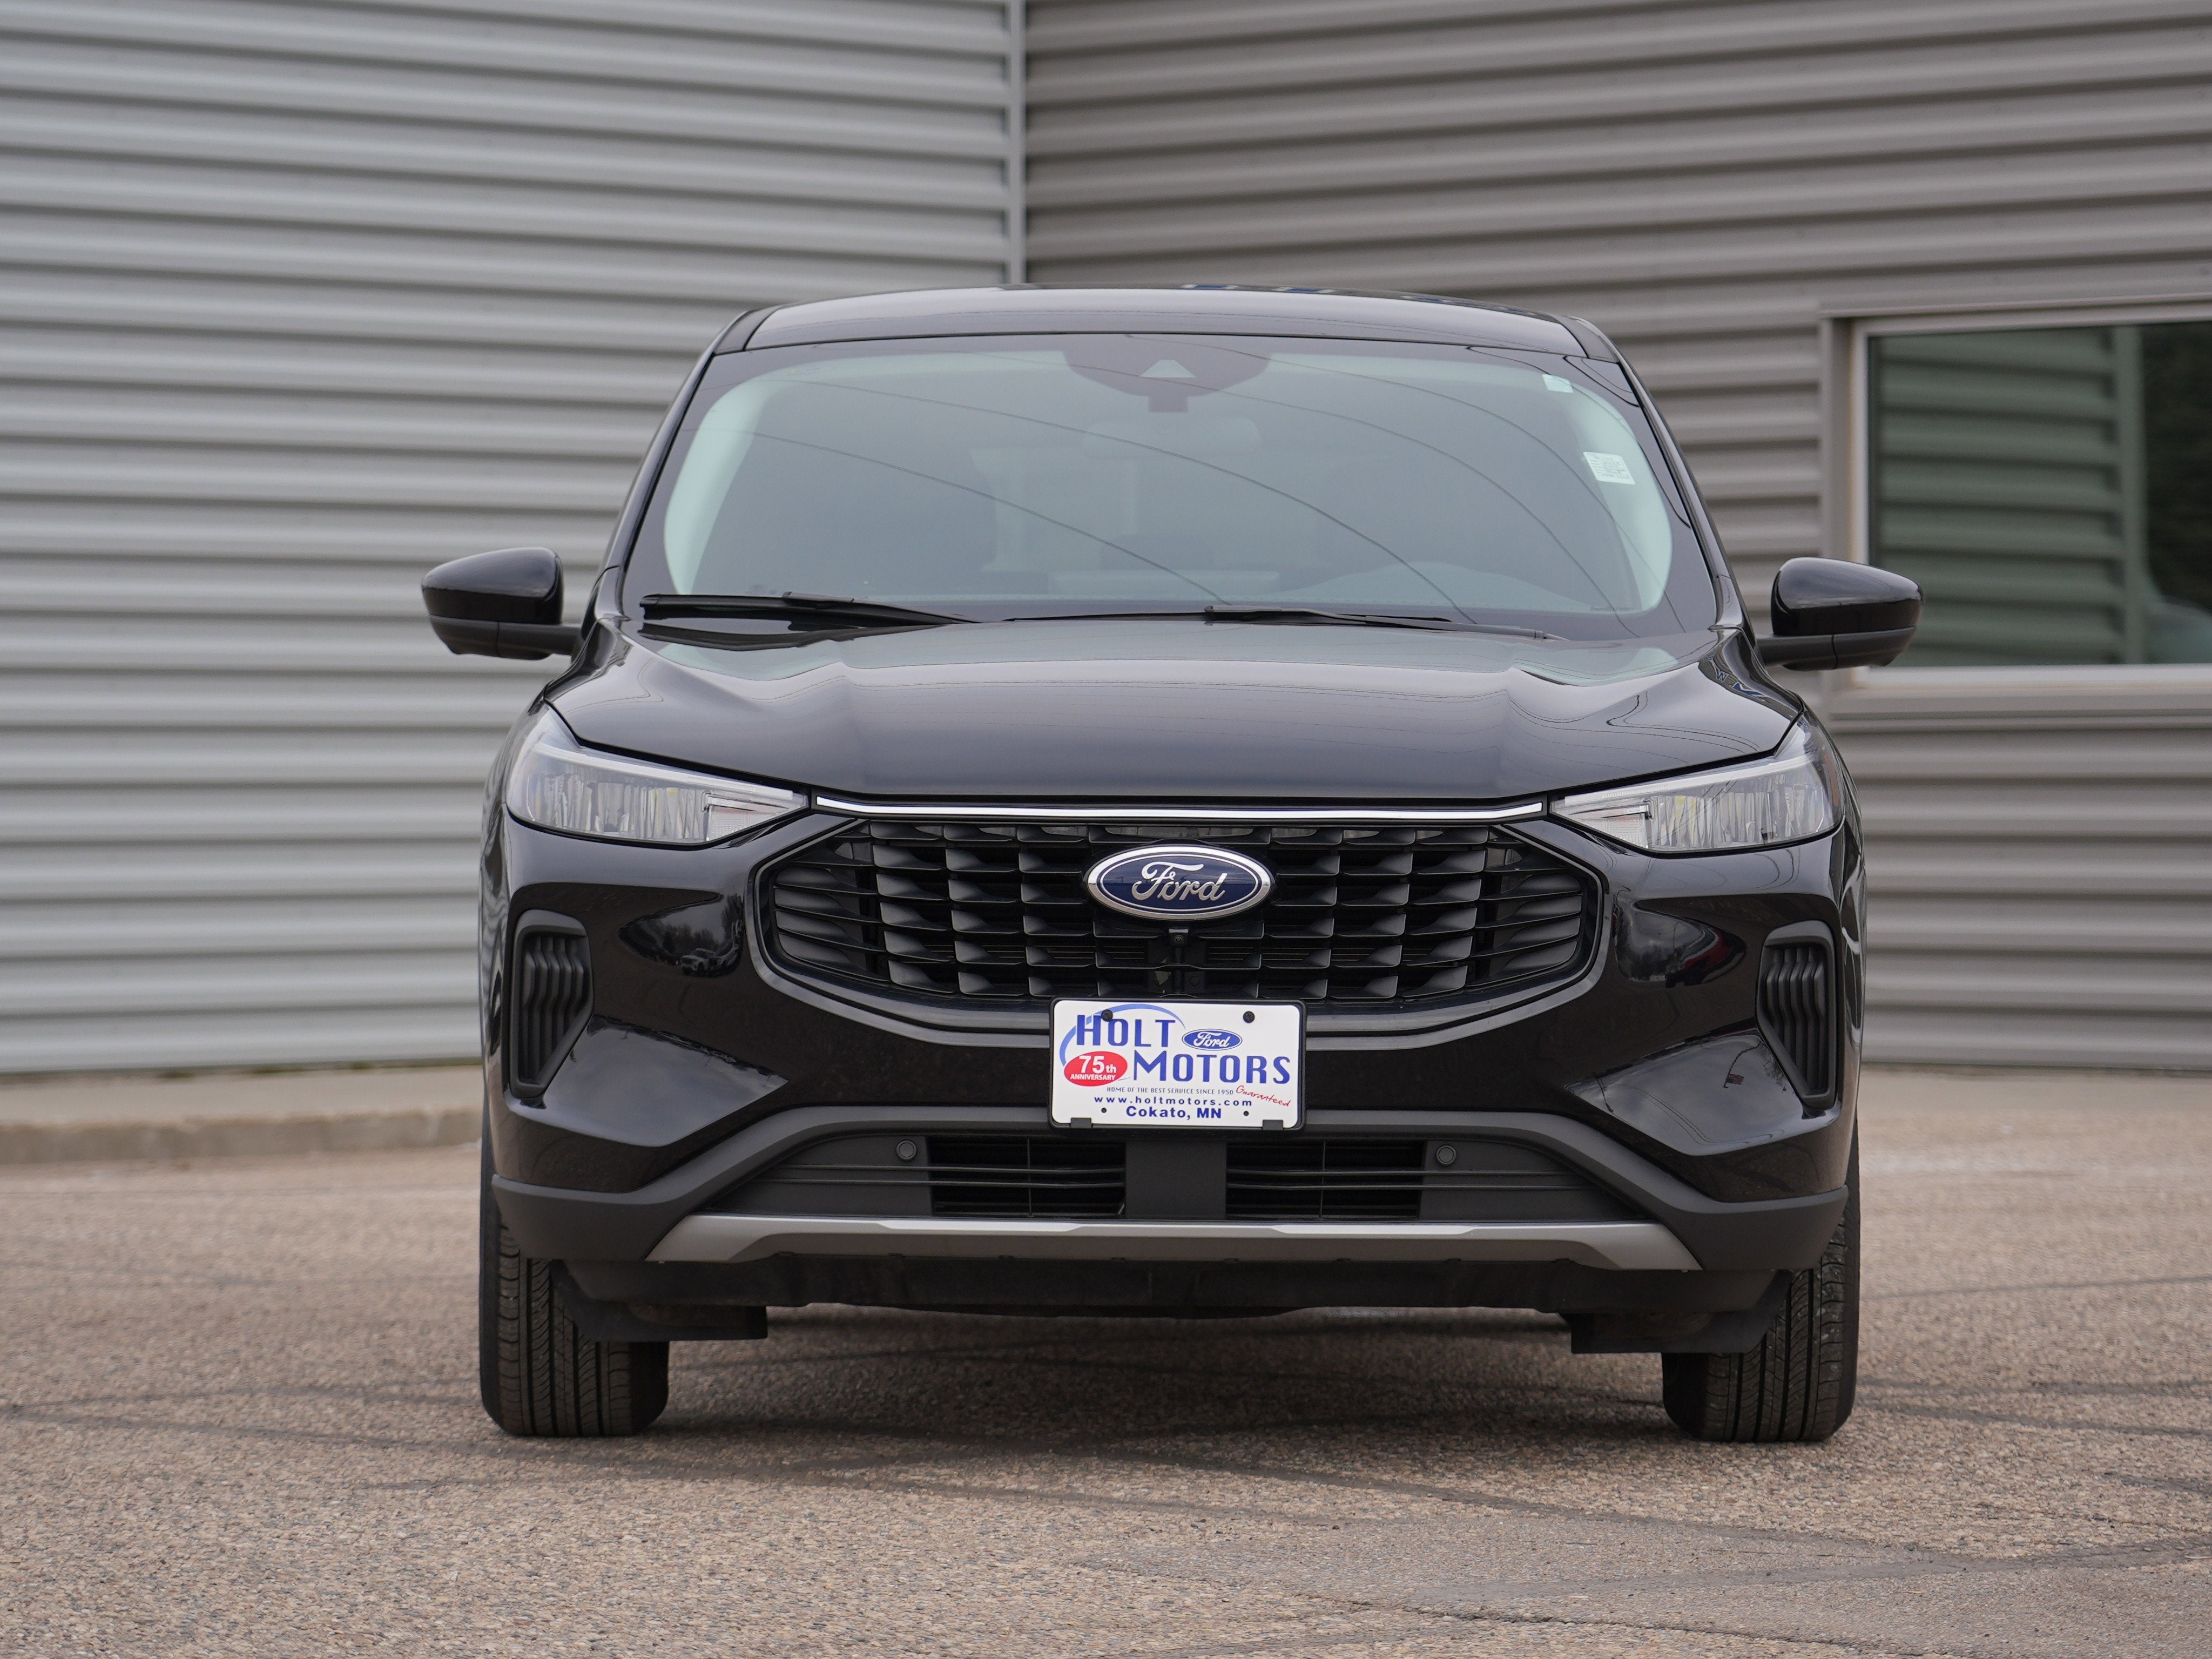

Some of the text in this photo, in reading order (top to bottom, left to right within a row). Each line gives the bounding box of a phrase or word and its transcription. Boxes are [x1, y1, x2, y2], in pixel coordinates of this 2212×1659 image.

[1131, 861, 1228, 901] Ford
[1077, 1014, 1176, 1048] HOLT
[1193, 1030, 1231, 1048] Ford
[1078, 1055, 1117, 1074] 75th
[1133, 1049, 1291, 1084] MOTORS
[1094, 1096, 1252, 1107] www.holtmotors.com
[1236, 1085, 1292, 1107] Guaranteed
[1126, 1105, 1222, 1121] Cokato, MN
